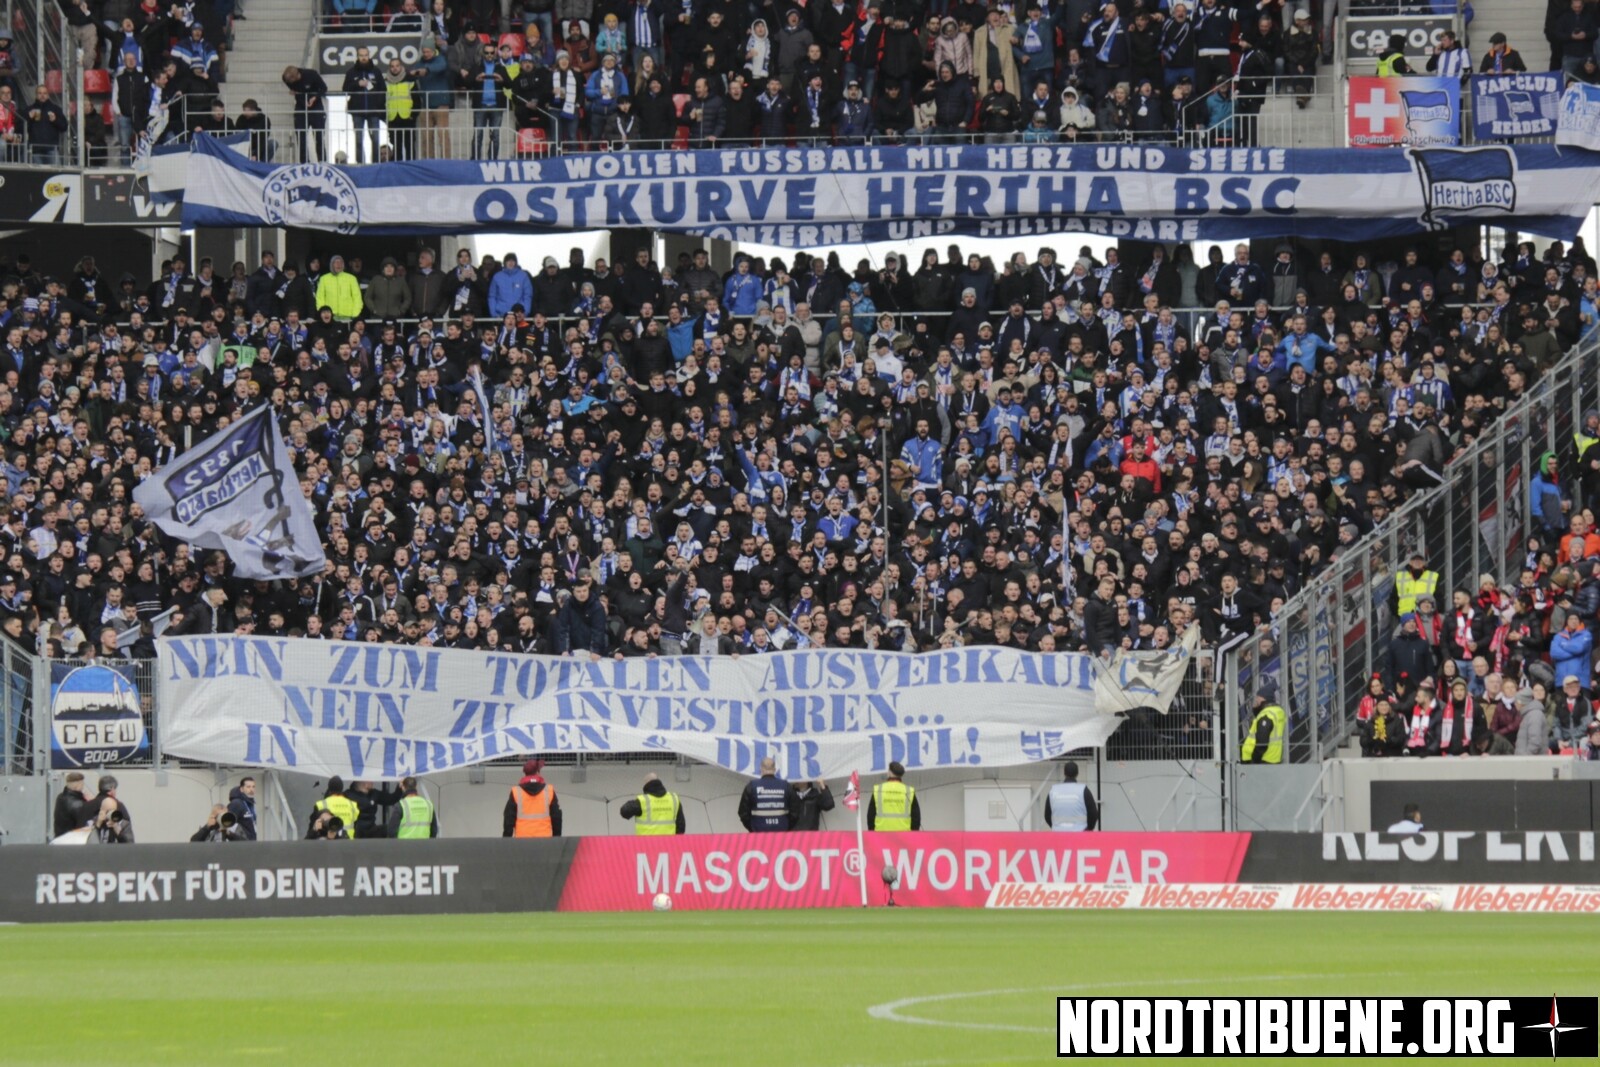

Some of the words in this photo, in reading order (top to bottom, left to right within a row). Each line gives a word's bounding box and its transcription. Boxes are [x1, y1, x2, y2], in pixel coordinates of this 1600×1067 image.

[1492, 117, 1552, 135] HERDER
[479, 160, 542, 183] WIR
[564, 152, 696, 180] WOLLEN
[720, 149, 883, 174] FUSSBALL
[906, 146, 963, 169] MIT
[986, 146, 1072, 169] HERZ
[1096, 147, 1166, 170] UND
[1189, 149, 1286, 171] SEELE
[270, 165, 351, 199] OSTKURVE
[1434, 184, 1483, 207] Hertha
[1484, 182, 1512, 204] BSC
[472, 176, 817, 228] OSTKURVE
[866, 174, 1126, 219] HERTHA
[1173, 176, 1301, 216] BSC
[888, 220, 956, 240] UND
[979, 217, 1199, 240] MILLIARDÄRE
[166, 637, 288, 681] NEIN
[327, 645, 442, 692] ZUM
[485, 655, 713, 700] TOTALEN
[758, 648, 1097, 693] AUSVERKAUF
[281, 684, 411, 733] NEIN
[449, 698, 515, 738] ZU
[554, 691, 944, 737] INVESTOREN...
[63, 723, 137, 745] CREW
[243, 722, 298, 767] IN
[344, 723, 612, 777] VEREINEN
[714, 736, 822, 780] DER
[869, 726, 982, 772] DFL!
[36, 871, 177, 904] RESPEKT
[185, 862, 247, 899] FÜR
[254, 867, 345, 898] DEINE
[352, 865, 460, 897] ARBEIT
[882, 848, 1169, 891] WORKWEAR
[994, 884, 1130, 908] WeberHaus
[1140, 884, 1280, 909] WeberHaus
[1453, 886, 1600, 911] WeberHaus
